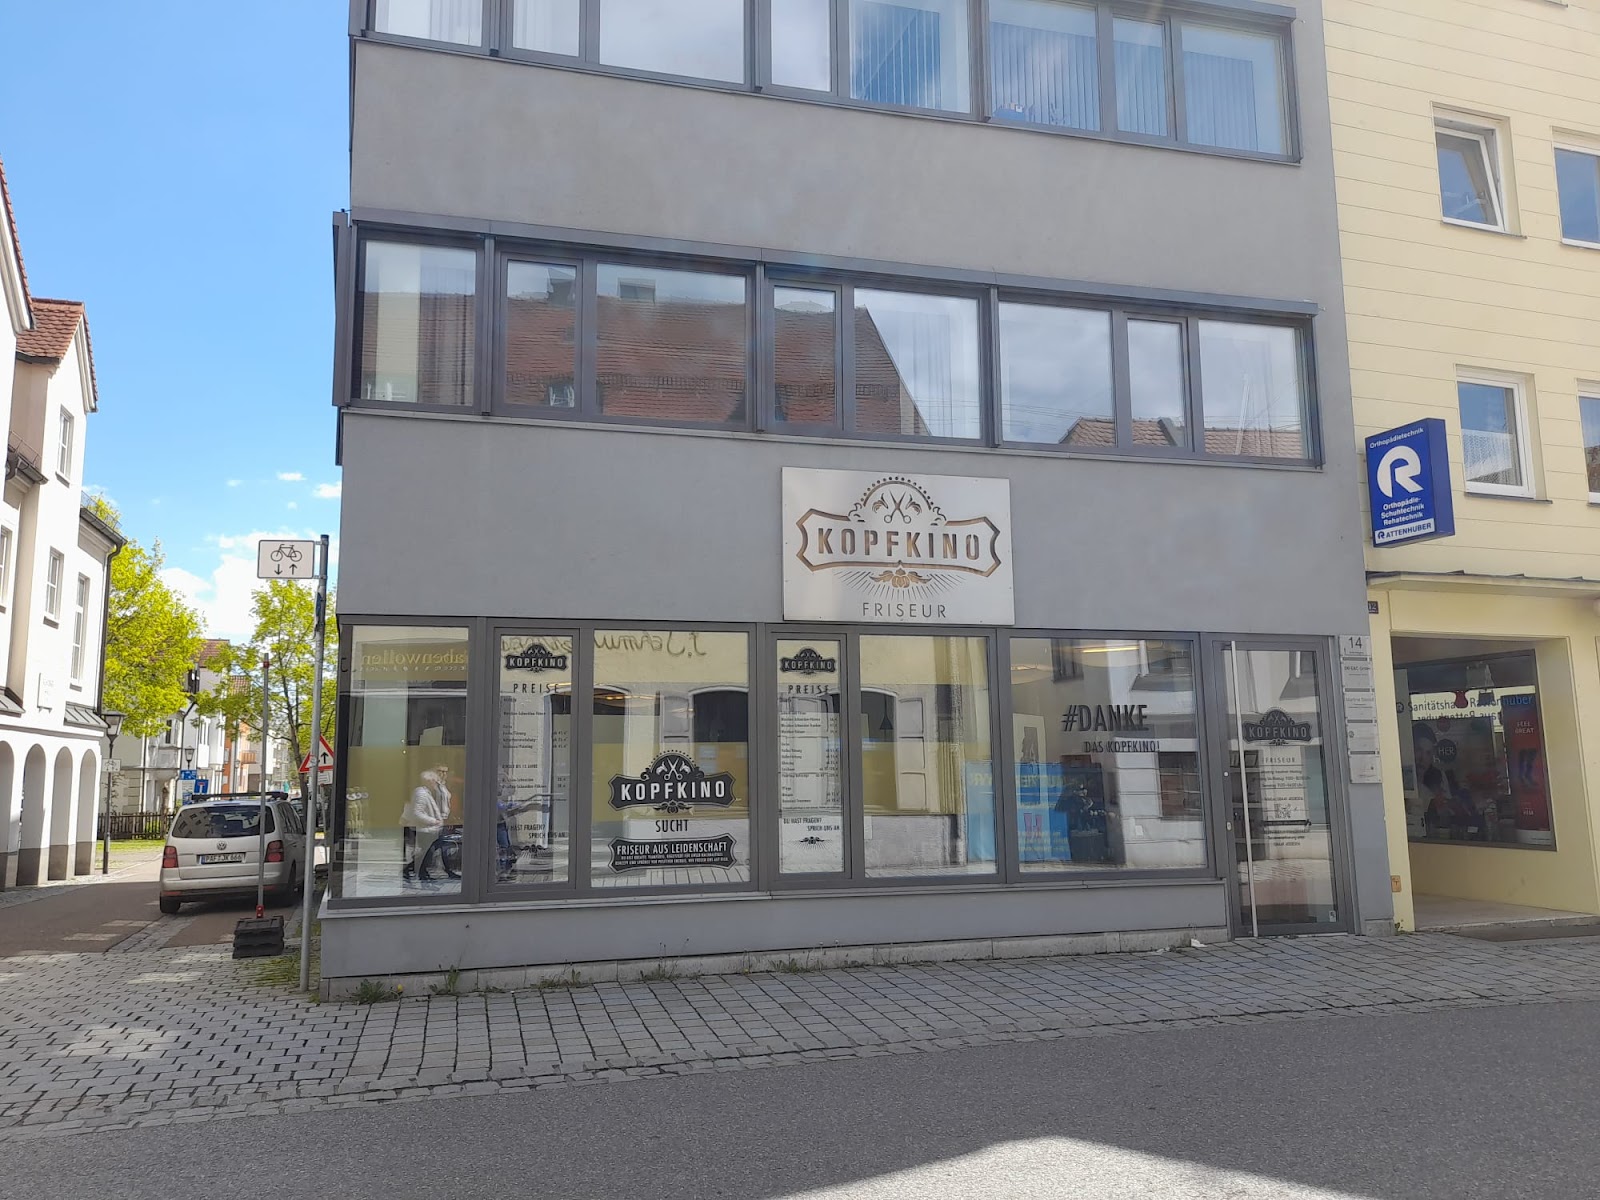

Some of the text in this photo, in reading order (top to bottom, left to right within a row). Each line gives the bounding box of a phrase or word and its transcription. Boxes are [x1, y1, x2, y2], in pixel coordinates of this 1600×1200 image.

[1370, 427, 1424, 449] Orthopädietechnik
[1381, 503, 1425, 519] Schuhtechnik
[1383, 497, 1421, 511] Orthopädie-
[1383, 511, 1423, 526] Rehatechnik
[817, 527, 980, 561] KOPFKINO
[862, 602, 946, 618] FRISEUR
[1348, 636, 1363, 649] 14
[509, 657, 564, 667] KOPFKINO
[784, 660, 832, 669] KOPFKINO
[513, 683, 560, 694] PREISE
[788, 684, 829, 695] PREISE
[1061, 704, 1150, 732] #DANKE
[1249, 726, 1307, 738] KOPFKINO
[1084, 740, 1161, 753] DAS KOPFKINO!
[621, 780, 726, 801] KOPFKINO
[655, 819, 689, 832] SUCHT
[617, 841, 727, 855] FRISEUR AUS LEIDENSCHAFT
